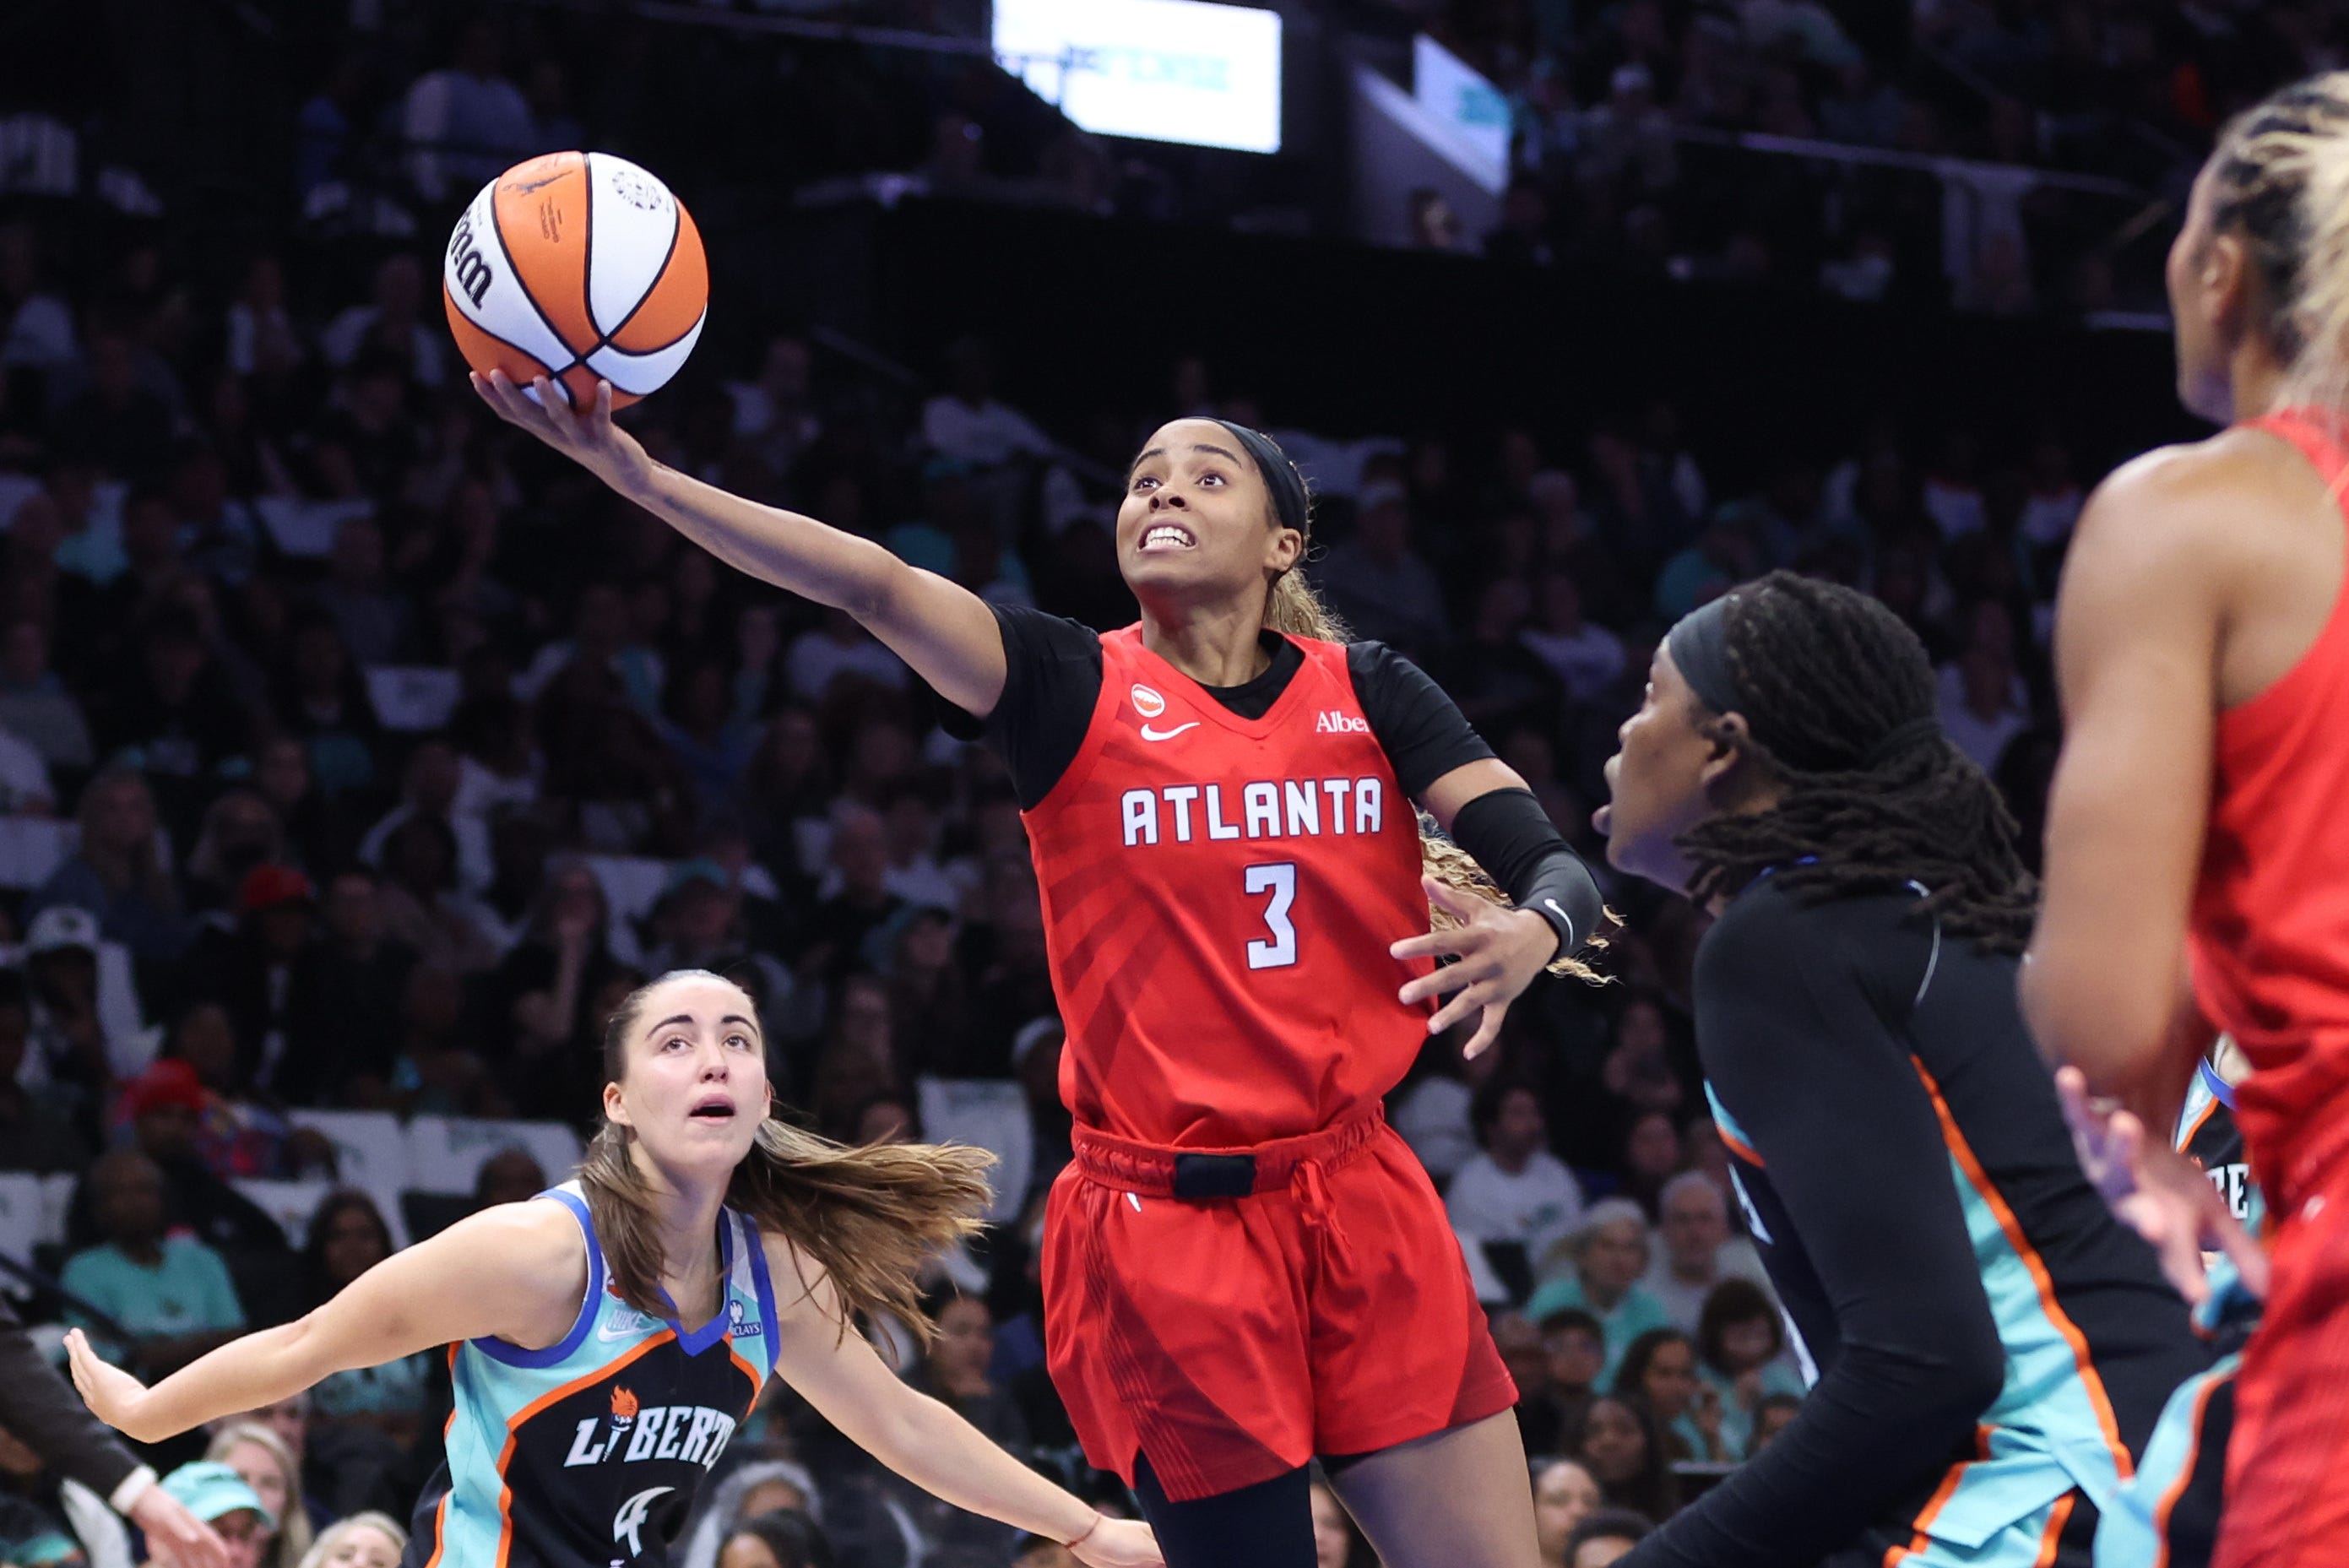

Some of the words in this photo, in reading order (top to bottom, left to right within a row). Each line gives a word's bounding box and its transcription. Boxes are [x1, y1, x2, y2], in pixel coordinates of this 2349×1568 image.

[1121, 777, 1382, 846] ATLANTA
[1244, 862, 1297, 970] 3
[614, 1486, 675, 1558] 4
